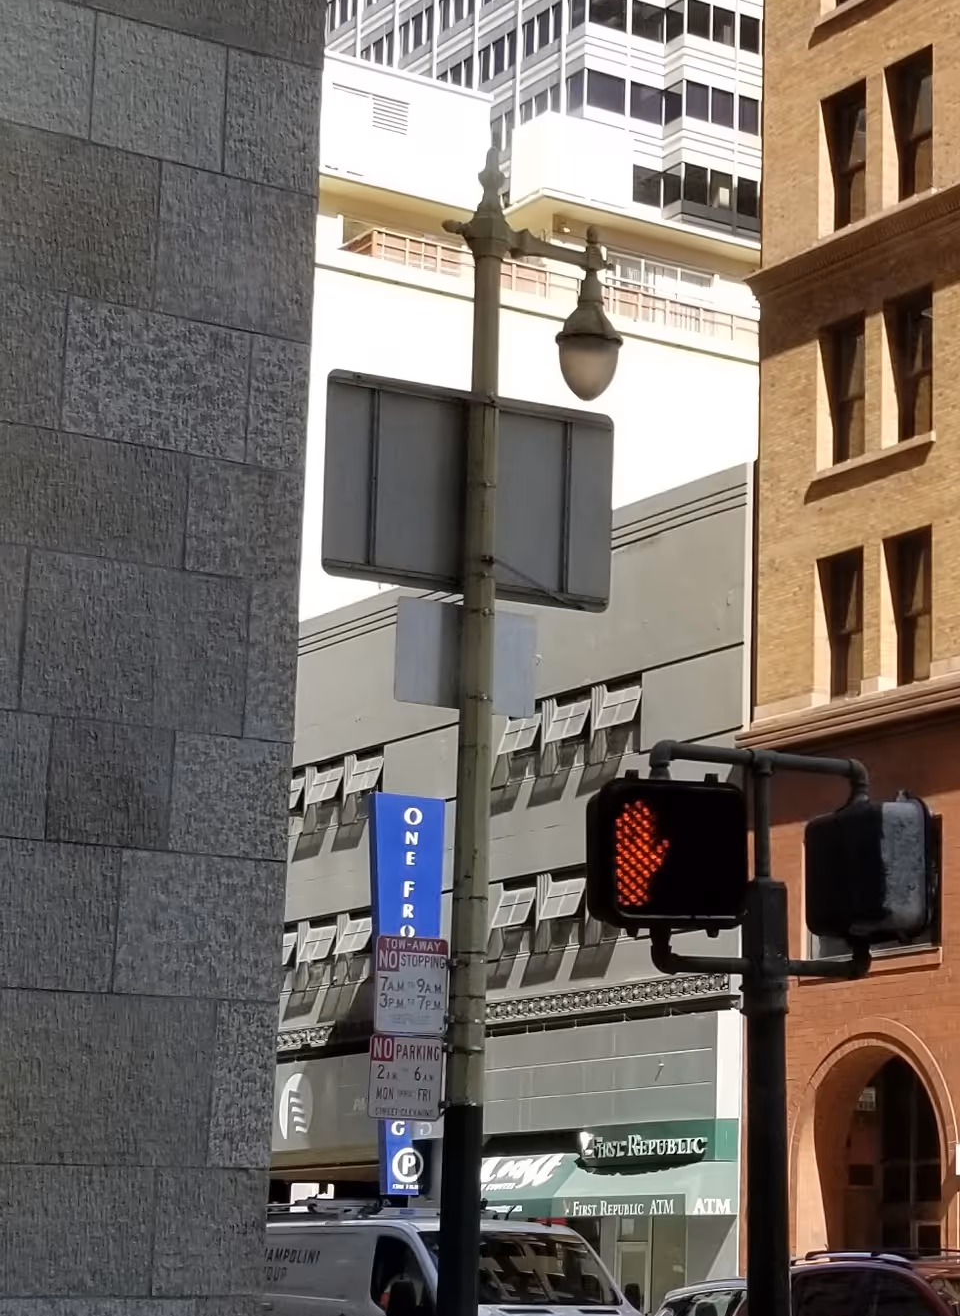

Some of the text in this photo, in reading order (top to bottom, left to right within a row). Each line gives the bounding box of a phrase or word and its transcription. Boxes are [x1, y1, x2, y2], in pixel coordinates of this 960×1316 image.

[404, 807, 423, 866] ONE
[385, 937, 441, 952] TOW-AWAY
[379, 949, 447, 970] NO STOPPING
[373, 1038, 440, 1062] NO PARKING
[375, 1087, 394, 1101] MON
[418, 1089, 432, 1102] FRI
[592, 1134, 708, 1158] FIRST REPUBLIC
[573, 1199, 674, 1216] FIRST REPUBLIC ATM
[693, 1198, 731, 1214] ATM
